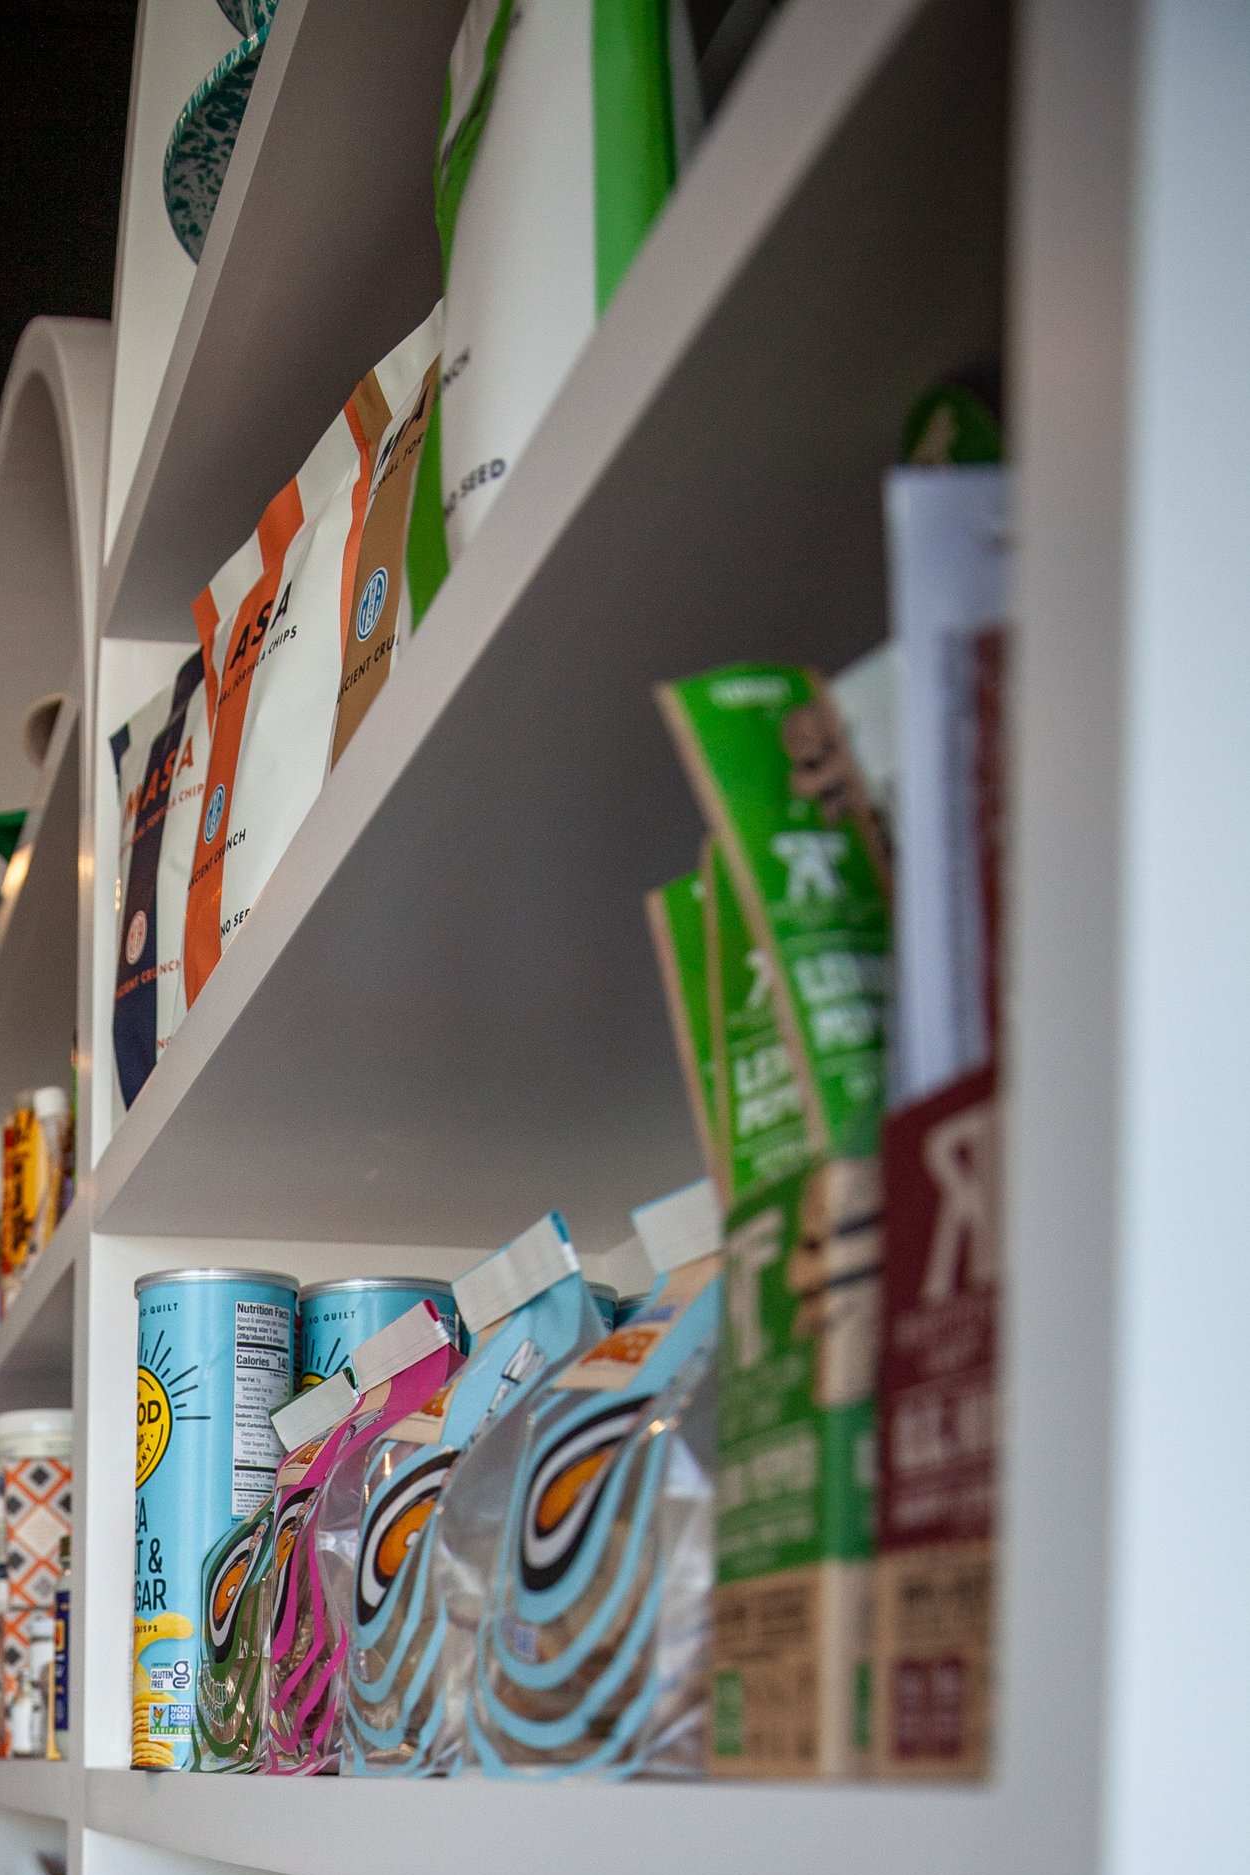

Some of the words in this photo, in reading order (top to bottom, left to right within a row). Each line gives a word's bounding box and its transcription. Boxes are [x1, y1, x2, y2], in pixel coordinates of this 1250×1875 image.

[268, 624, 297, 654] CHIPS
[373, 632, 400, 664] CRU
[178, 782, 205, 803] CHIP
[214, 828, 246, 865] CRUNCH
[220, 920, 232, 939] NO
[150, 1302, 179, 1315] GUILT
[236, 1302, 274, 1316] Nutrition
[274, 1306, 289, 1320] Facts
[323, 1310, 358, 1323] GUILT
[236, 1323, 258, 1333] Serving
[236, 1355, 270, 1368] Calories
[148, 1537, 163, 1574] &
[151, 1670, 174, 1680] GLUTEN
[151, 1680, 164, 1689] FREE
[170, 1705, 190, 1713] NON
[170, 1712, 190, 1720] GMO
[150, 1728, 190, 1736] VERIFIED
